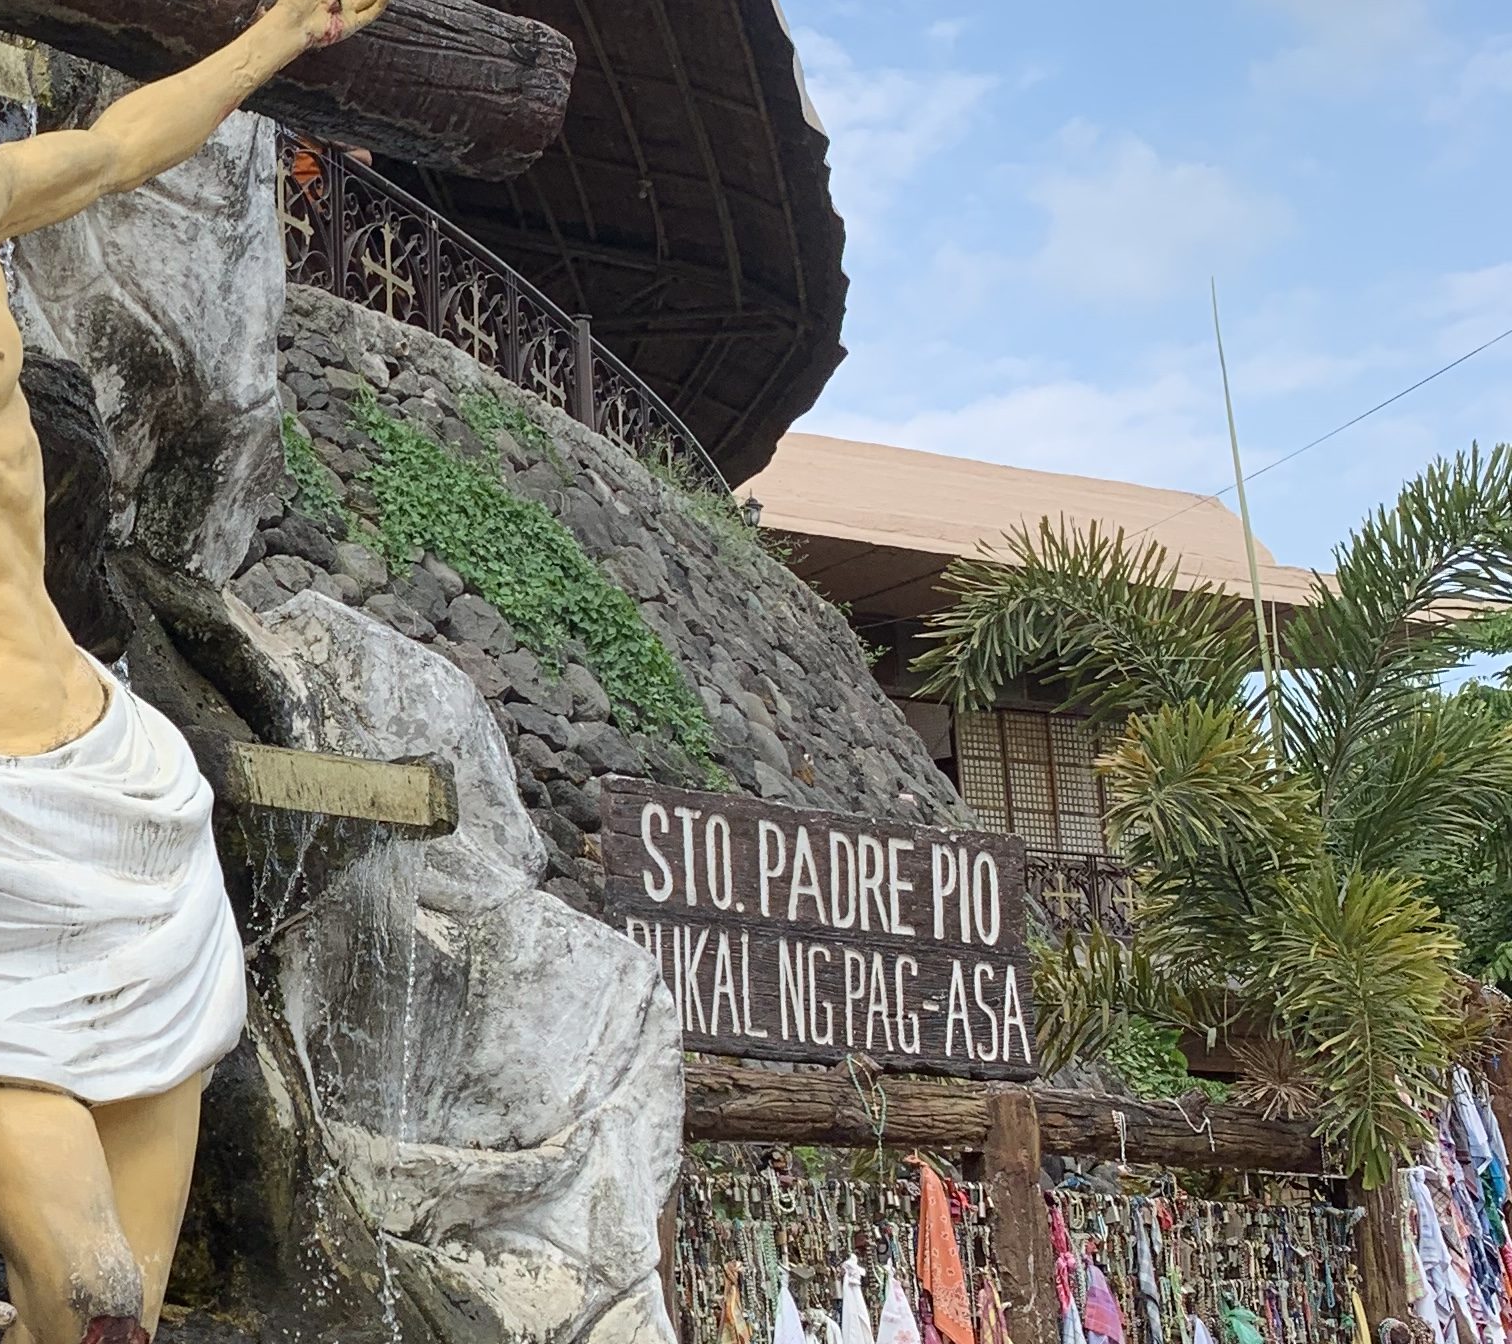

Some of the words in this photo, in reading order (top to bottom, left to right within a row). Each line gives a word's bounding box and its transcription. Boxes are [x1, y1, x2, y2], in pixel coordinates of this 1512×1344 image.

[641, 802, 745, 914] STO.
[759, 819, 916, 937] PADRE
[932, 843, 1001, 947] PIO
[779, 937, 834, 1047] NG
